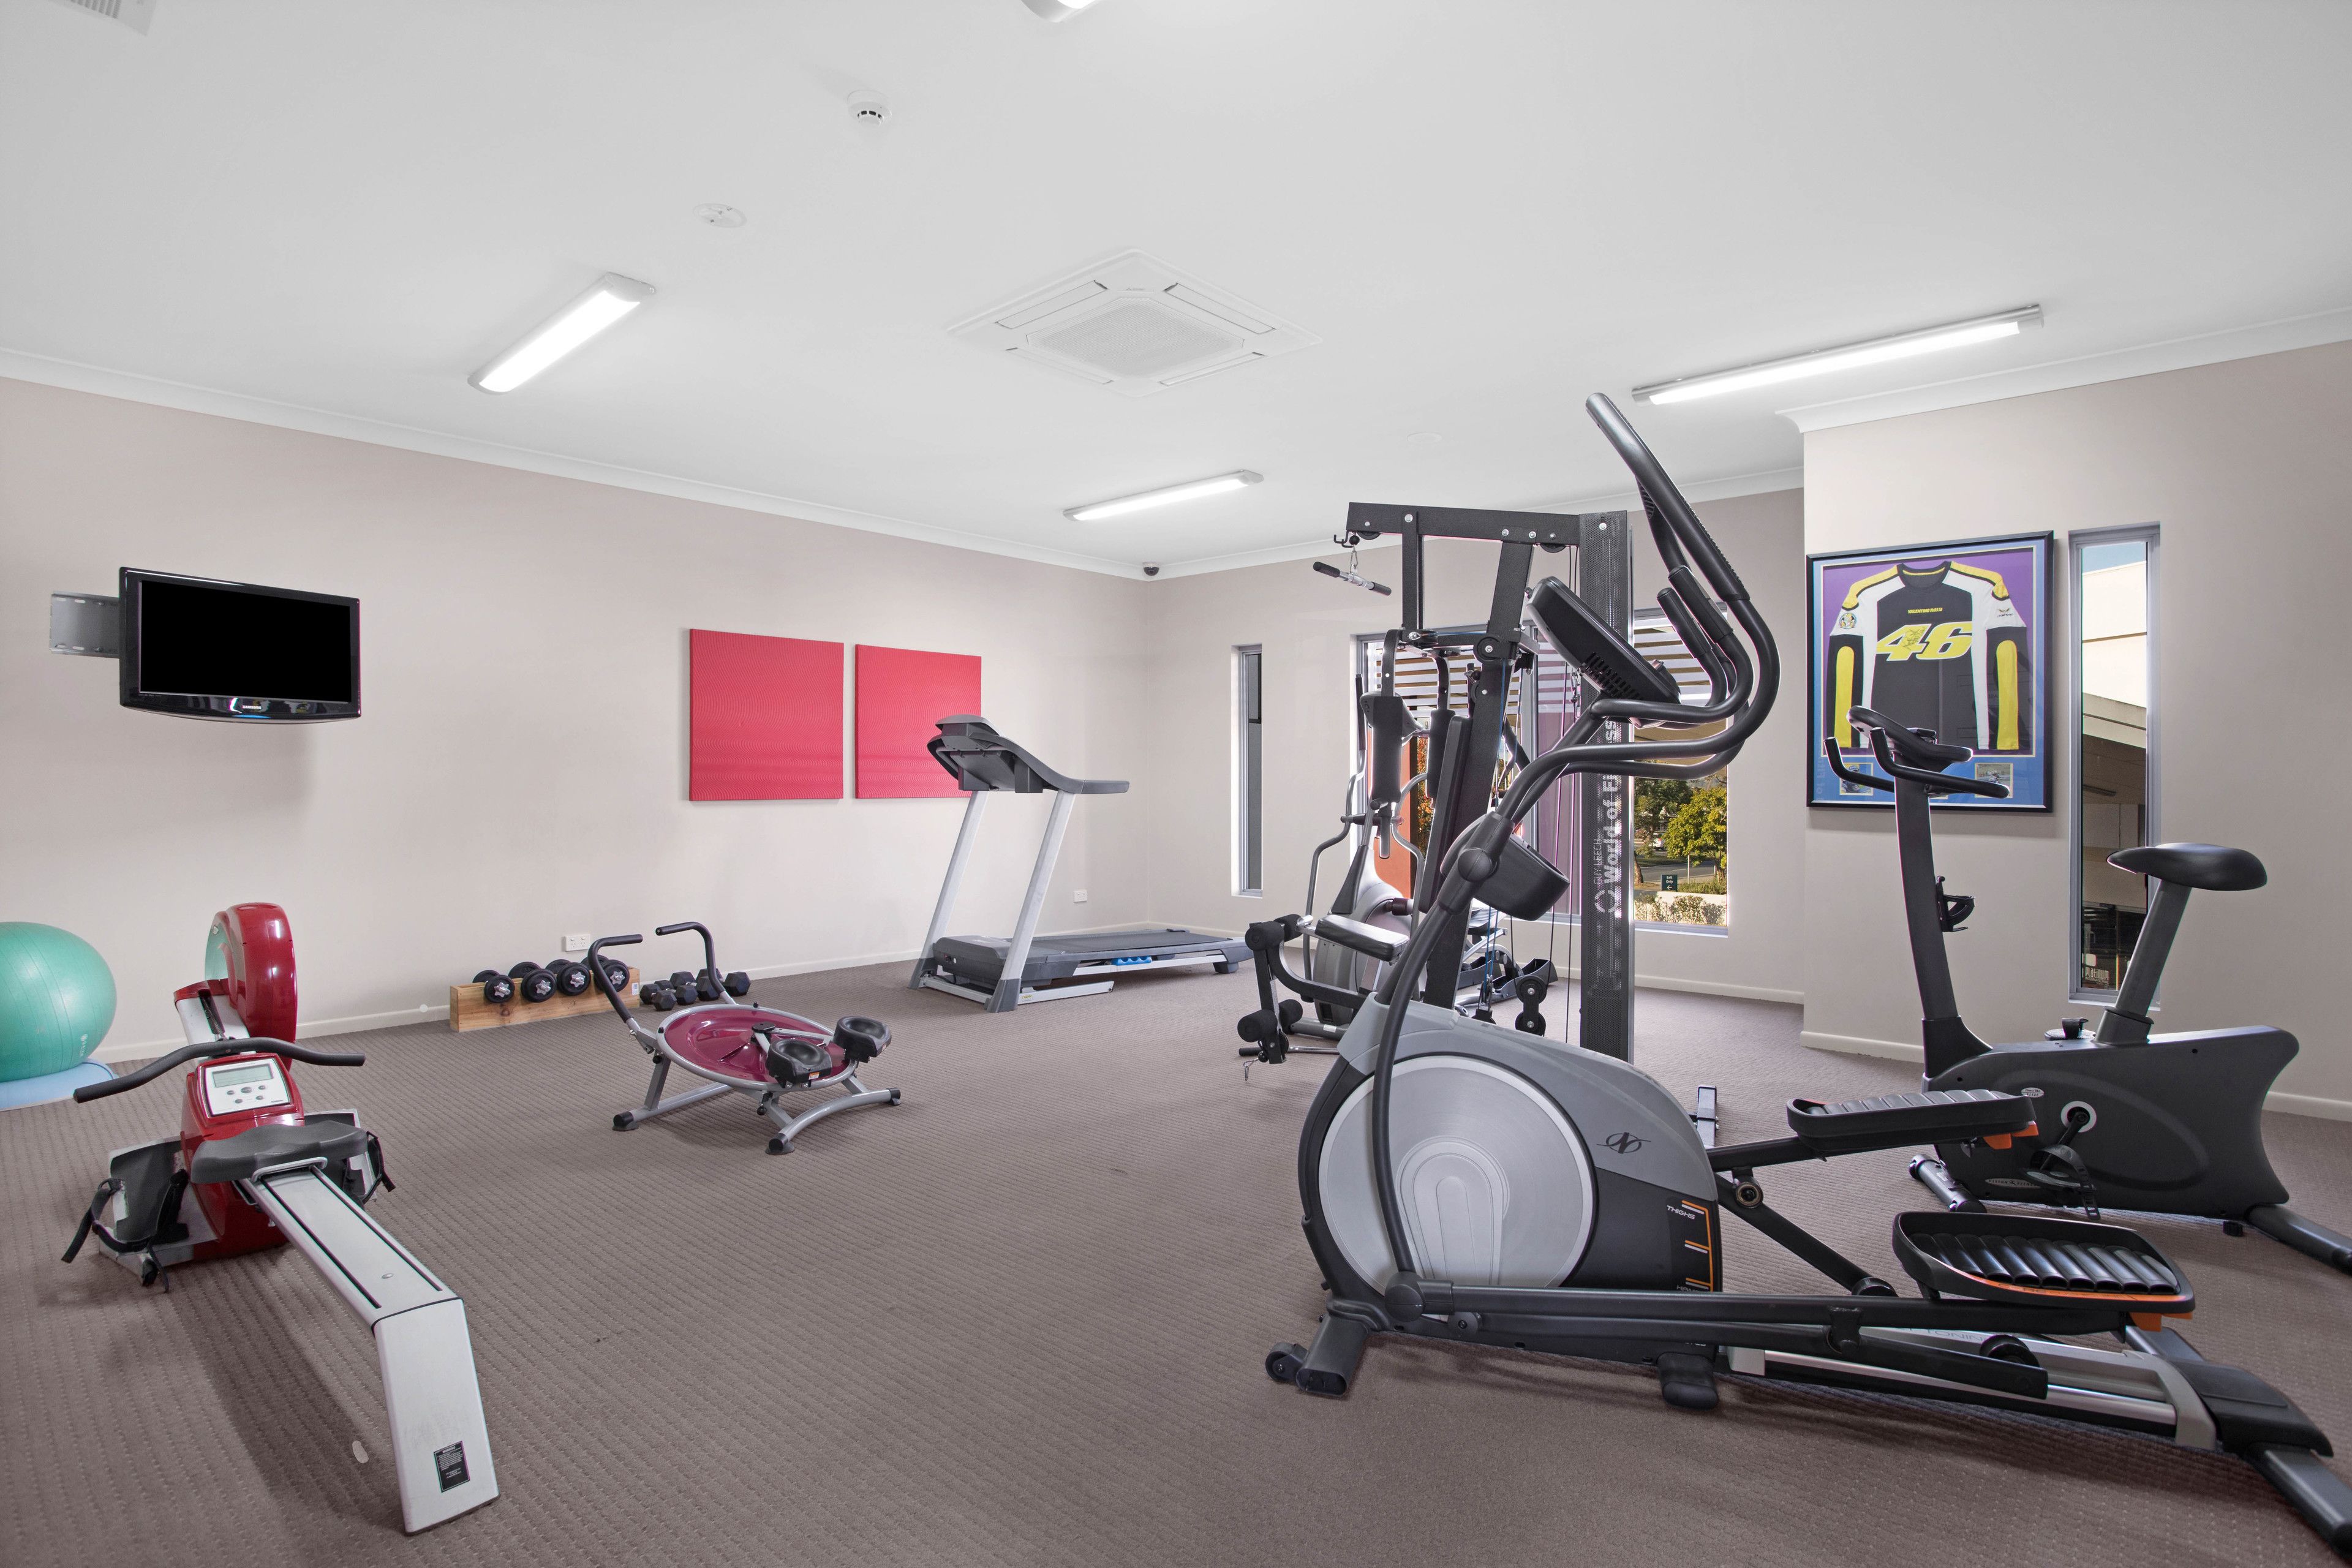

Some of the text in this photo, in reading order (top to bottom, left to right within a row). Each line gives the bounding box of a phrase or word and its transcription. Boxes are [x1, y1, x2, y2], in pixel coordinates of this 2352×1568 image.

[1876, 621, 1972, 662] 46
[1603, 799, 1618, 820] of
[1594, 839, 1602, 865] LEECH
[1603, 826, 1618, 884] World
[1667, 1205, 1696, 1219] THIGHS
